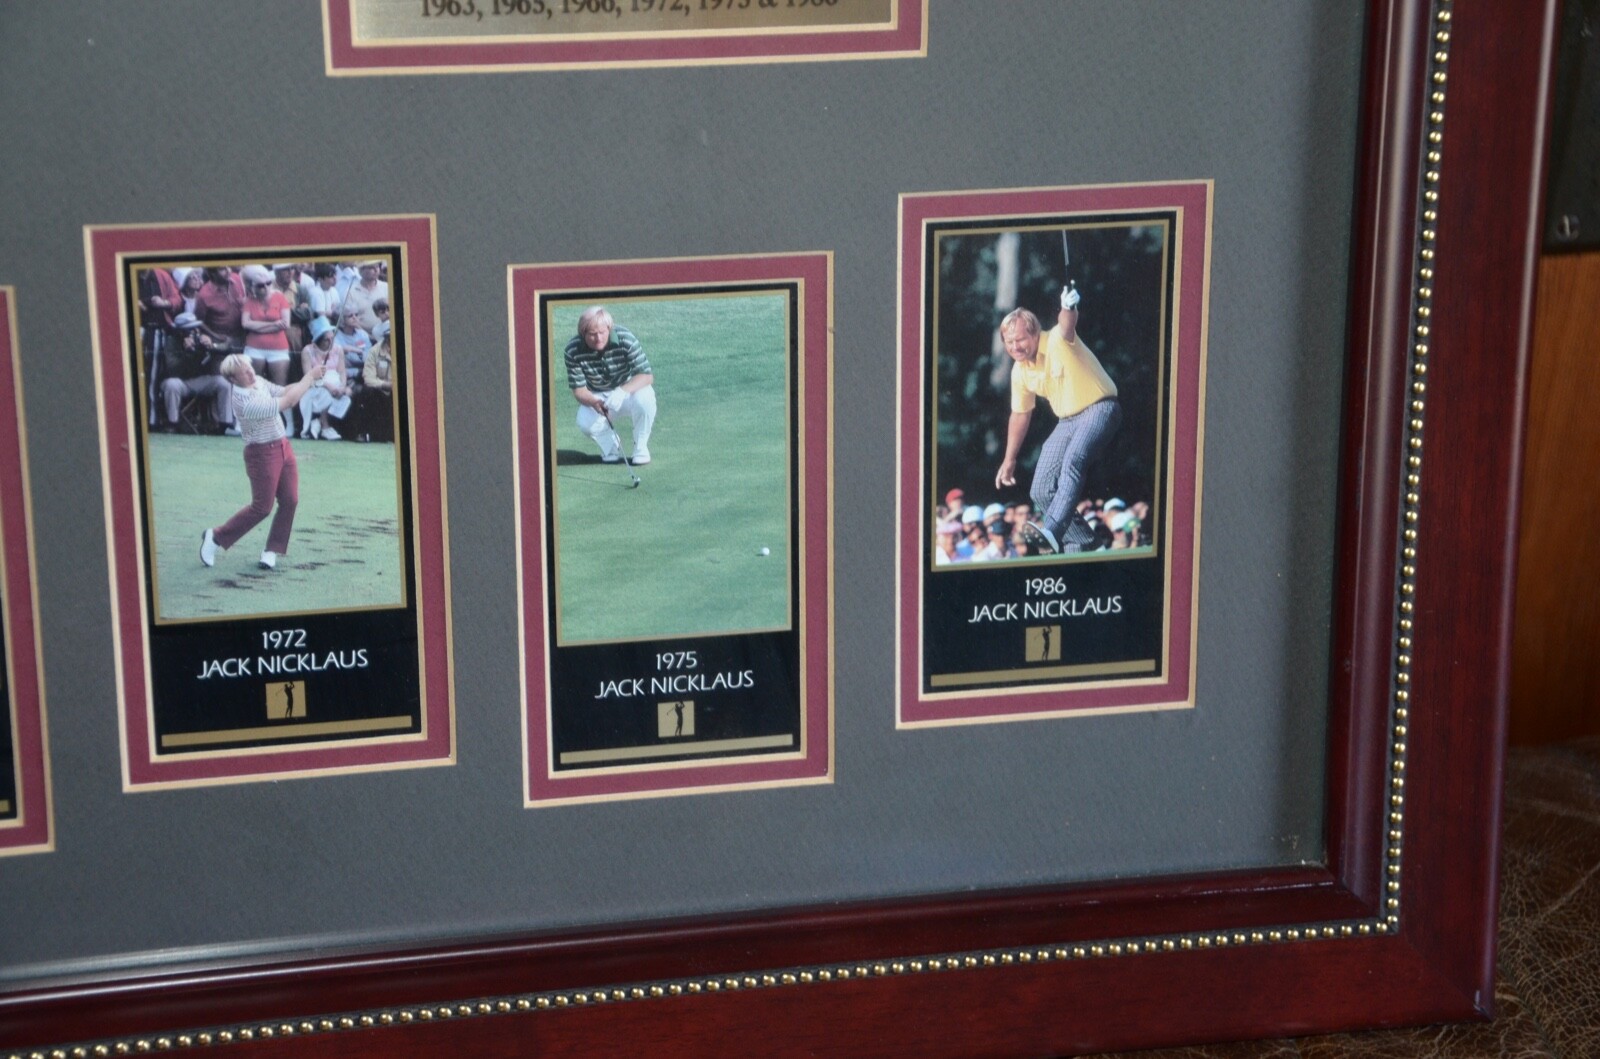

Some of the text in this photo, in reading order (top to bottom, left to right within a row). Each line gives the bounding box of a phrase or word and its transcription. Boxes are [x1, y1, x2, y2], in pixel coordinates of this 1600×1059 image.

[1025, 577, 1067, 596] 1986
[968, 595, 1122, 623] JACK NICKLAUS
[262, 629, 307, 649] 1972
[197, 649, 369, 679] JACK NICKLAUS
[656, 651, 698, 671] 1975
[594, 670, 754, 700] JACK NICKLAUS
